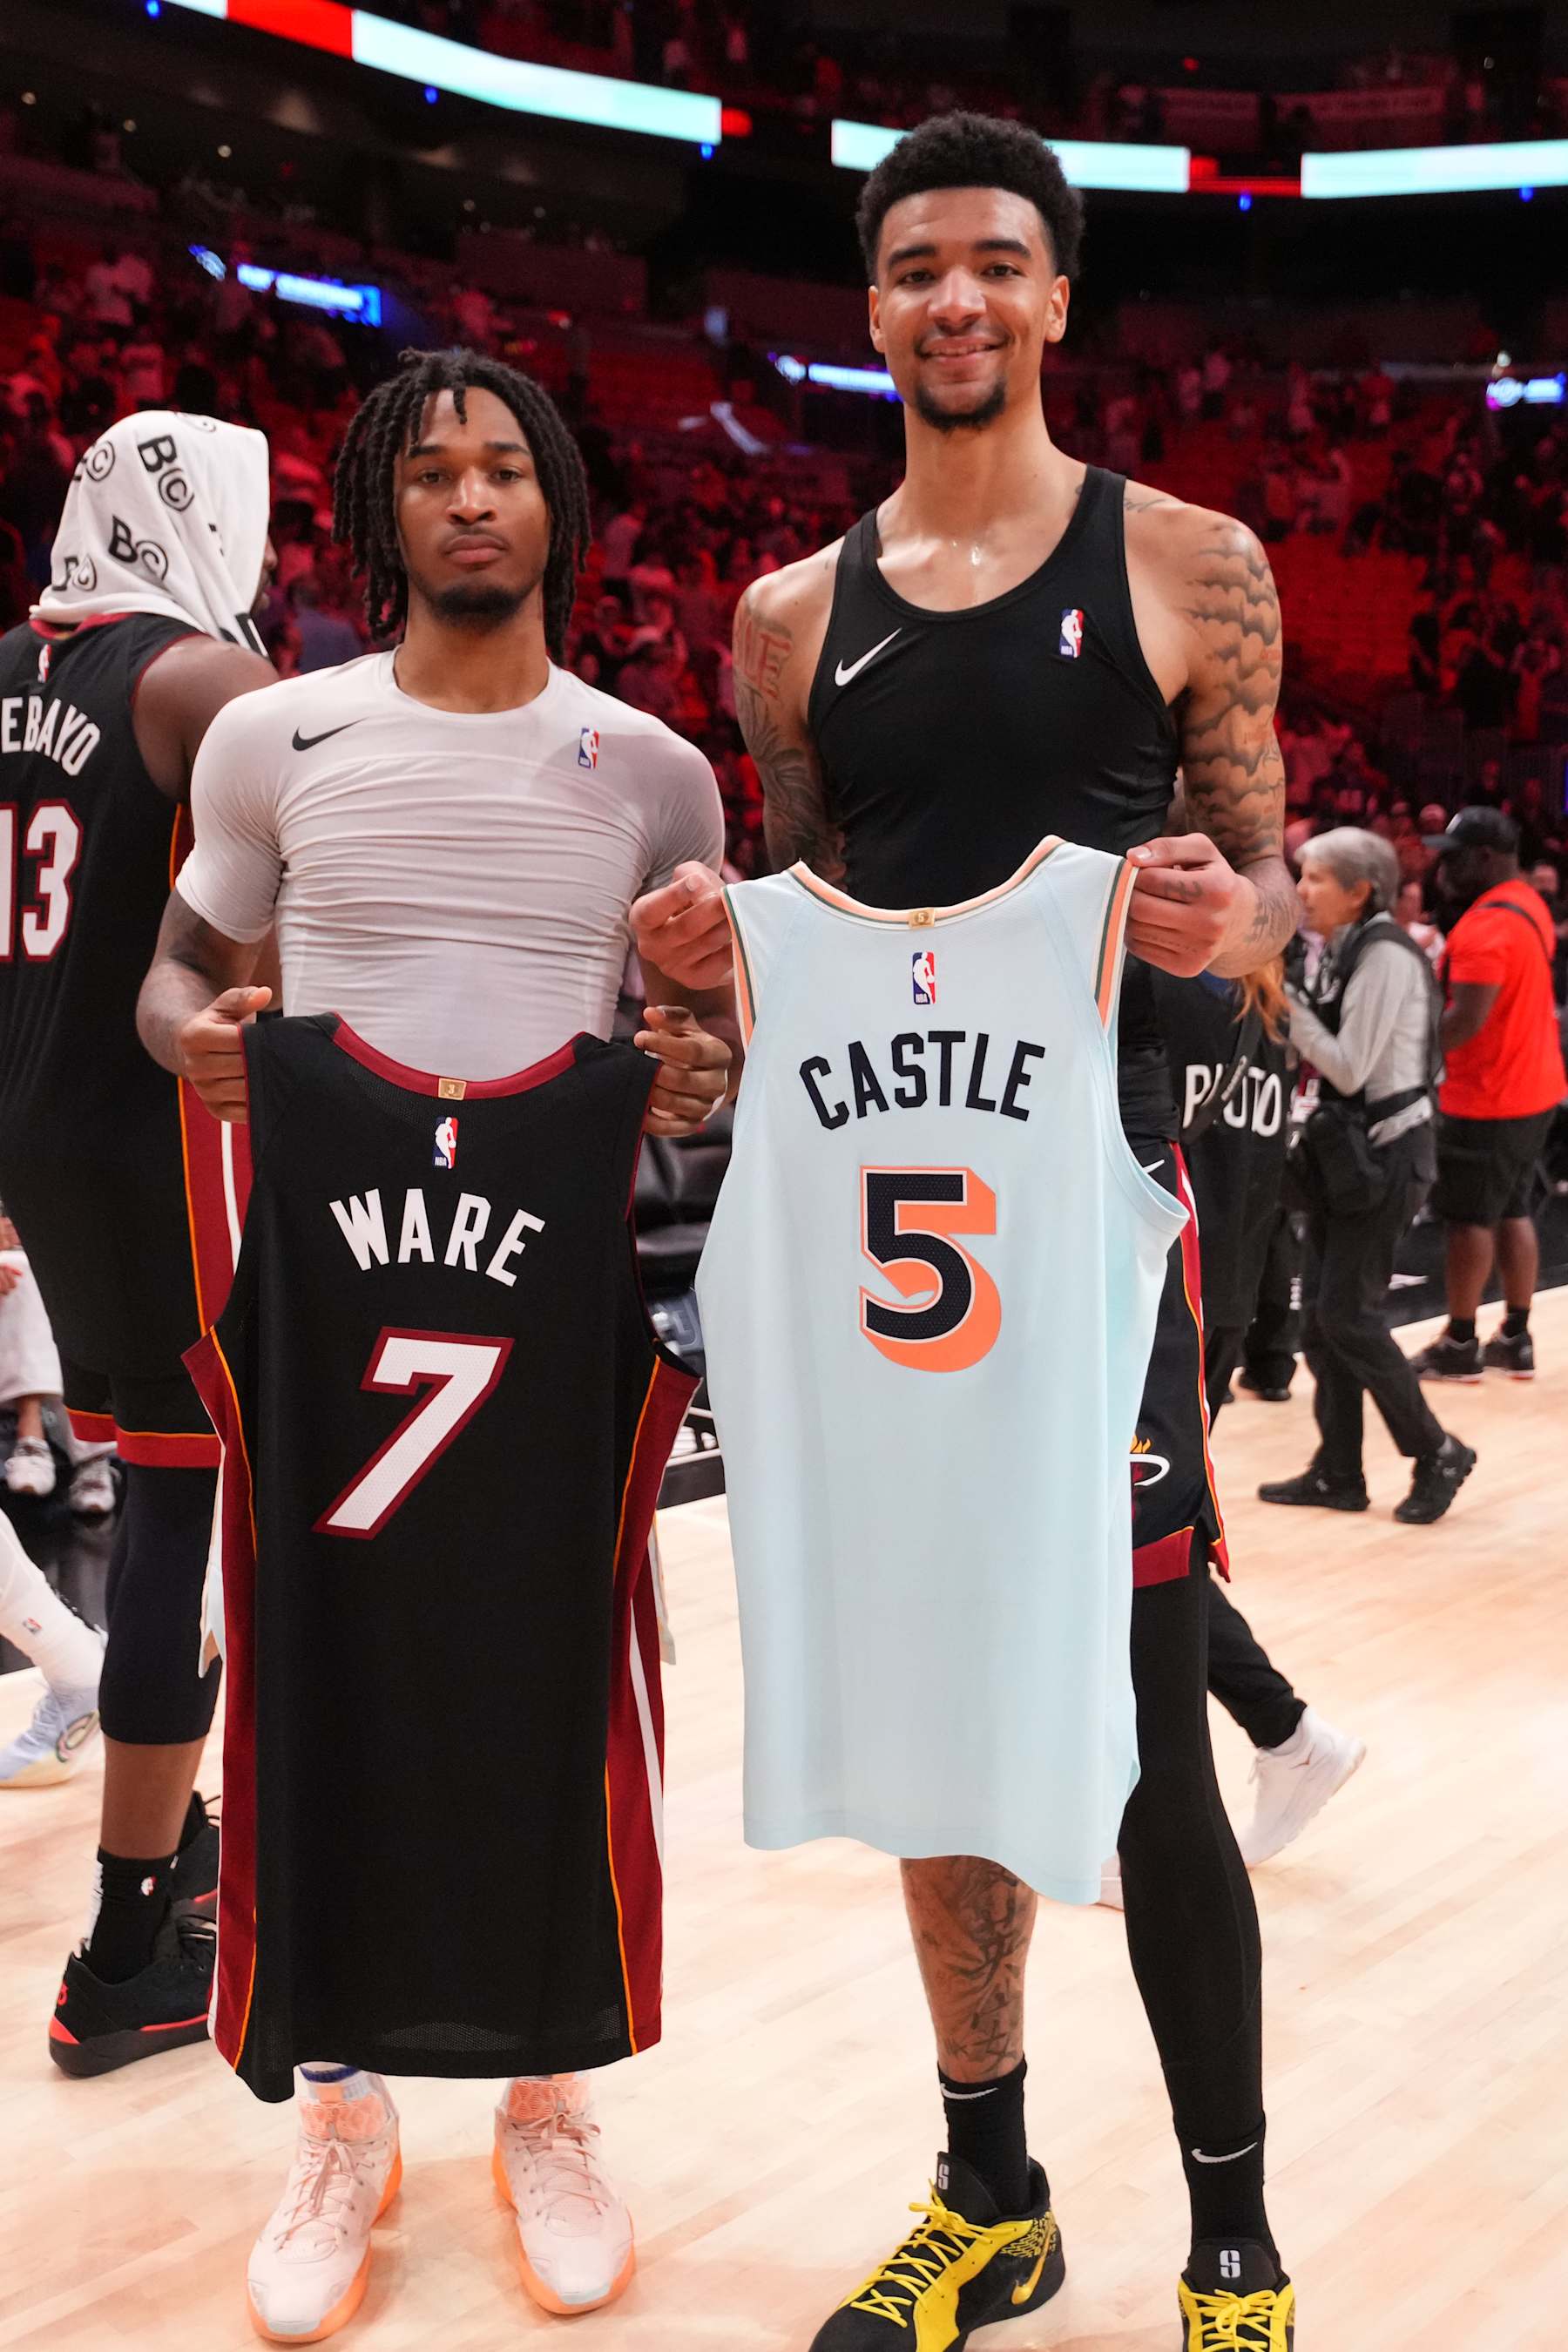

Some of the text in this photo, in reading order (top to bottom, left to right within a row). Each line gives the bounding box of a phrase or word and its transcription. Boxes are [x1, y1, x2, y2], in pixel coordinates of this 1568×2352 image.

[1, 695, 101, 776] EBAYO
[799, 1031, 1046, 1131] CASTLE
[328, 1188, 546, 1288] WARE
[860, 1165, 1003, 1374] 5
[312, 1325, 515, 1541] 7
